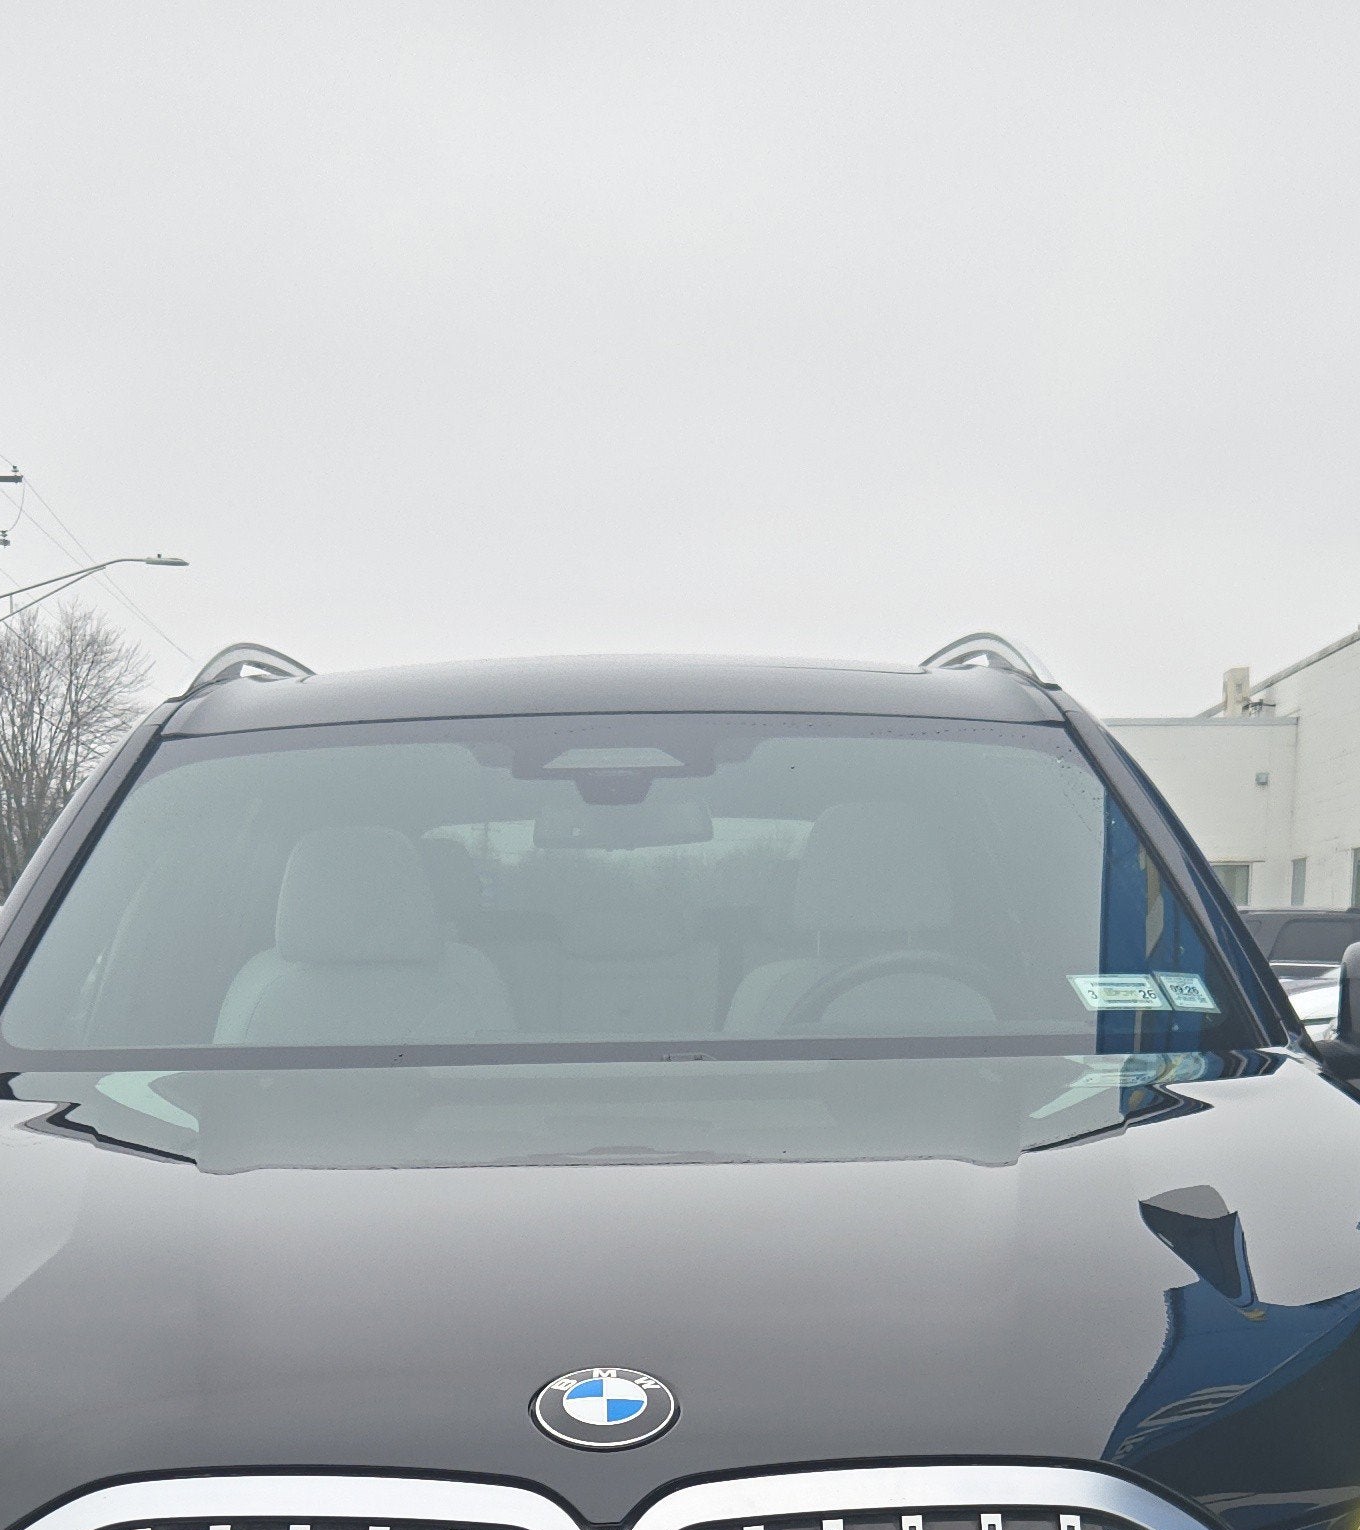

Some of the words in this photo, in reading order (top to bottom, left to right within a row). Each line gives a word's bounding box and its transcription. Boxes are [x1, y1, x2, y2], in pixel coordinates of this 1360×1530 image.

[1087, 989, 1098, 999] 3
[1139, 989, 1157, 999] 26
[550, 1369, 661, 1391] BMW
